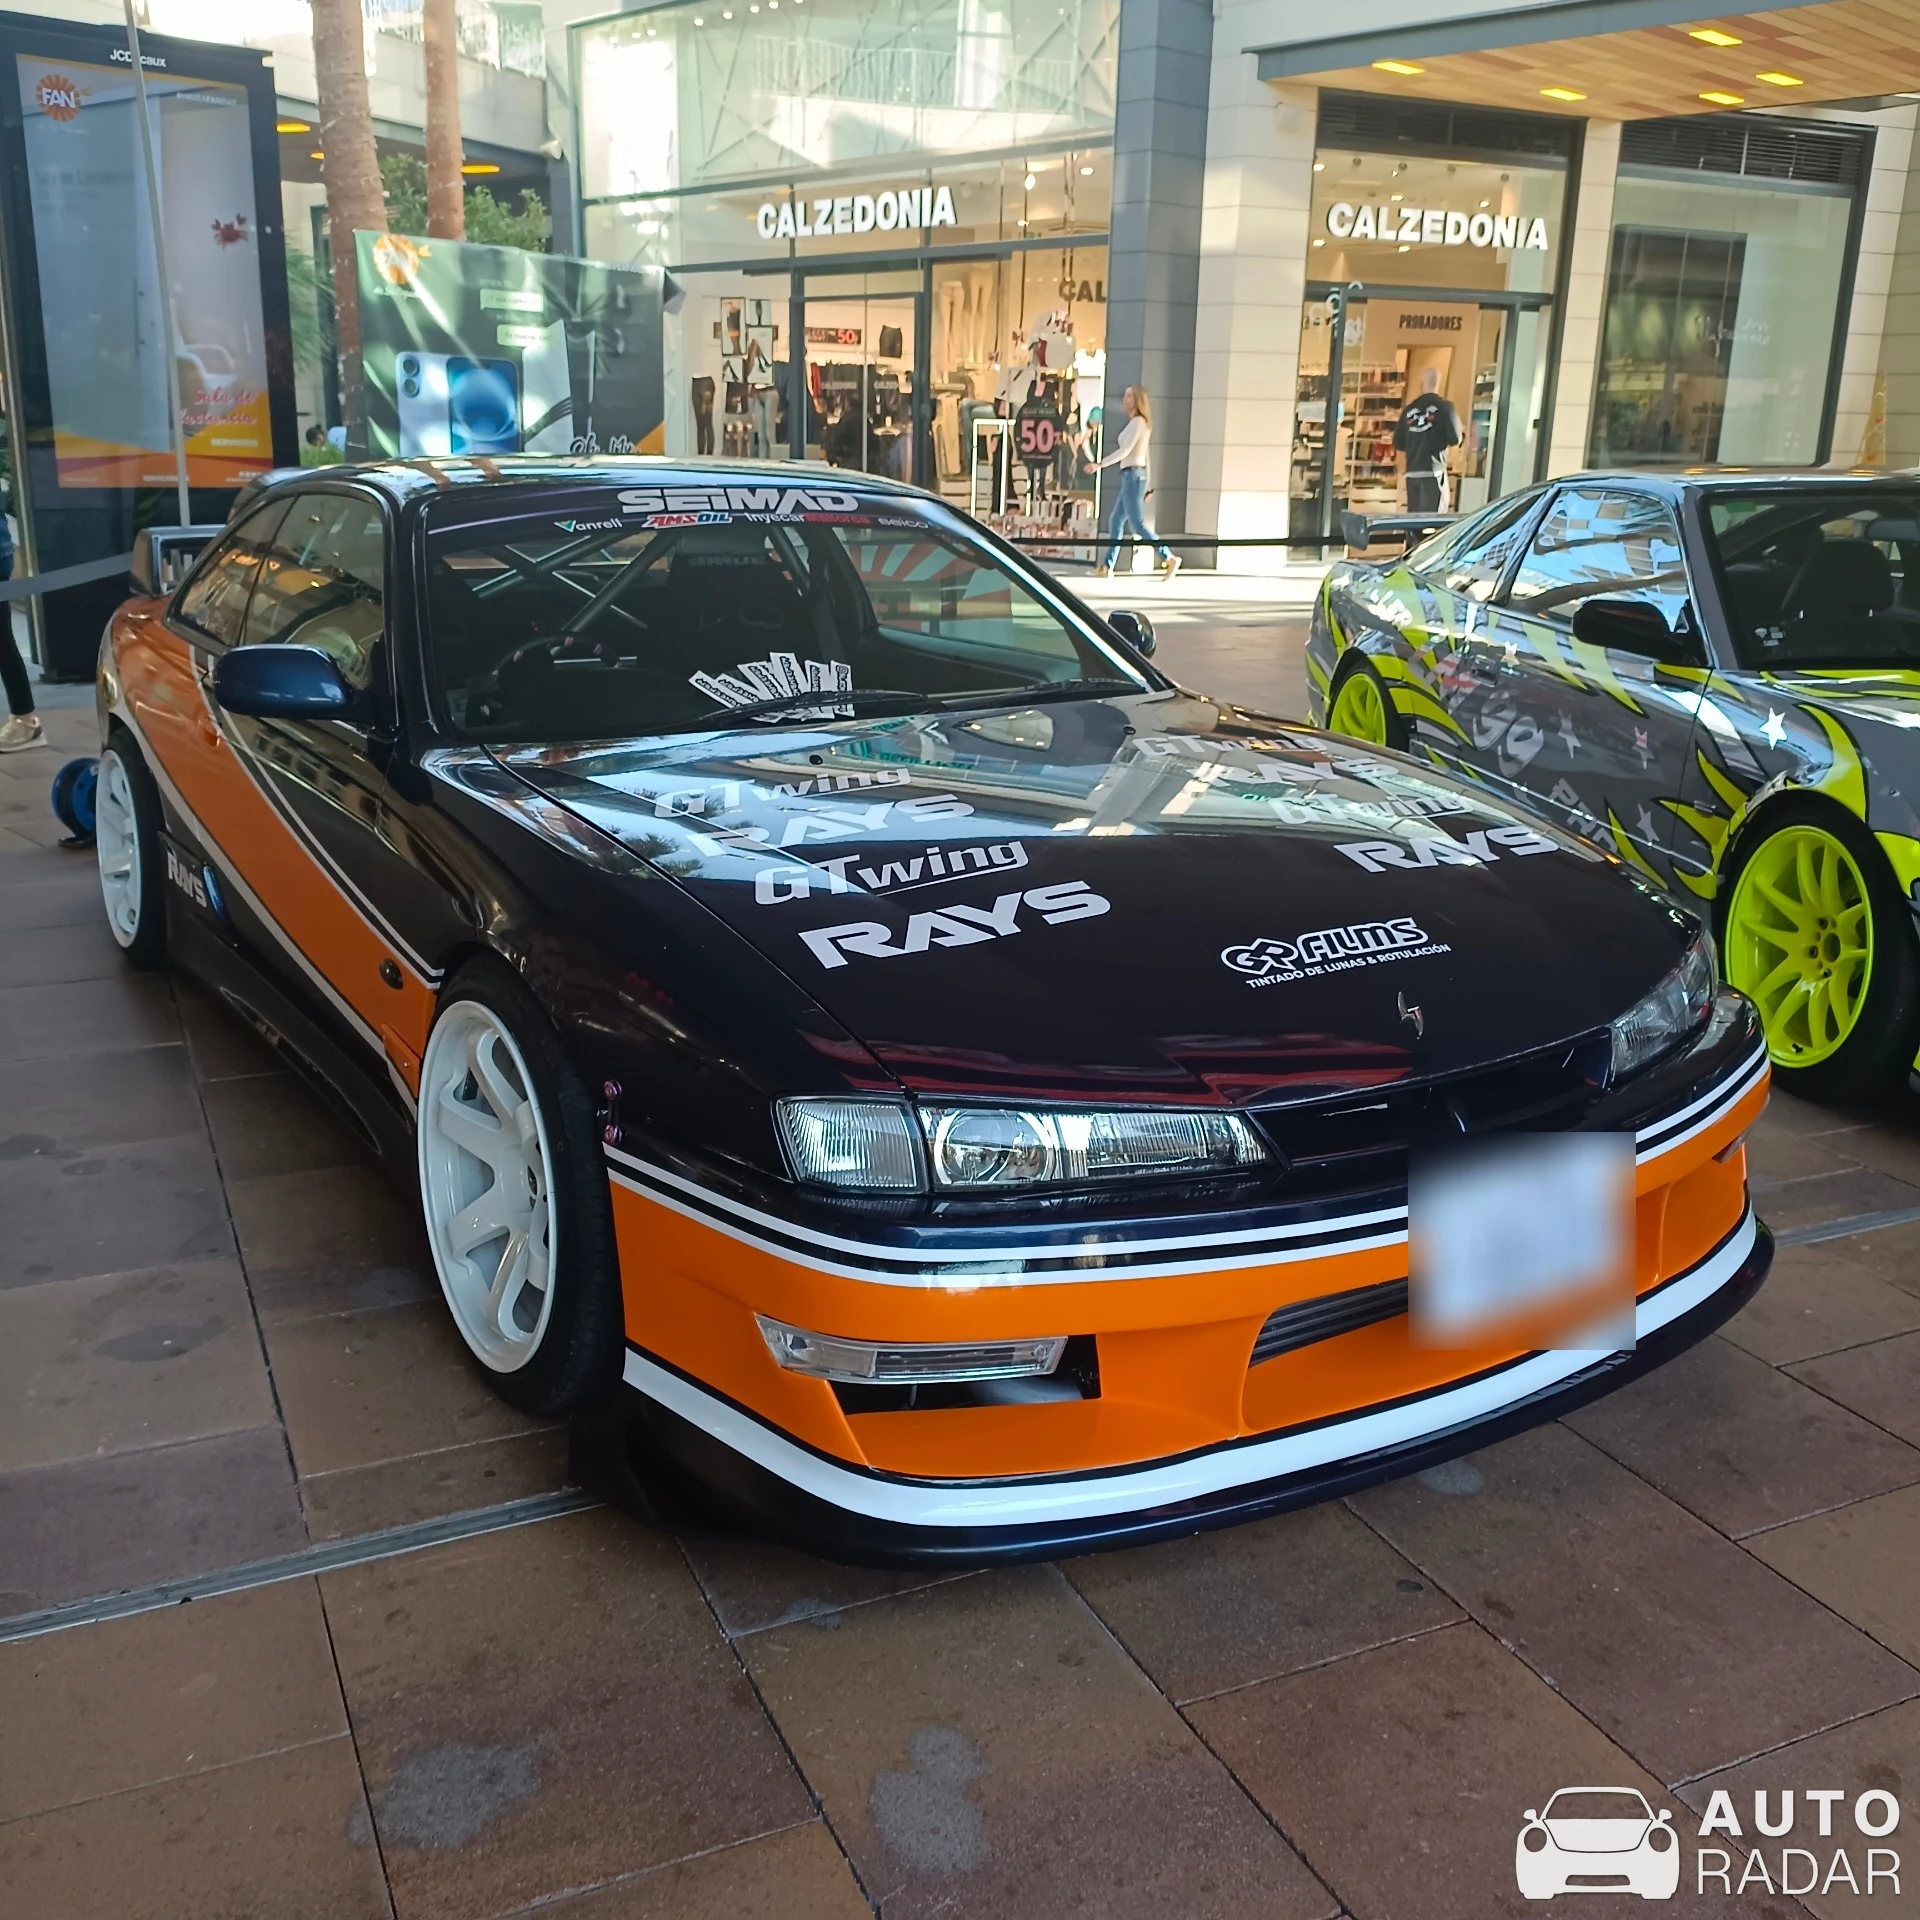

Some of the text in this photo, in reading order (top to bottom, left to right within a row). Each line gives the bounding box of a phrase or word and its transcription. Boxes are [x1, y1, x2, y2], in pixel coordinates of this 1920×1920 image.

[110, 49, 166, 67] JCDcaux
[42, 88, 76, 109] FAN
[756, 186, 957, 239] CALZEDONIA
[1327, 202, 1548, 250] CALZEDONIA
[1399, 314, 1463, 331] PROBADORES
[554, 518, 622, 533] Vanrell
[641, 511, 733, 529] AMSOIL
[655, 768, 912, 818] GTwing
[1187, 757, 1400, 787] RAYS
[686, 793, 975, 857] RAYS
[1333, 825, 1559, 873] RAYS
[167, 852, 207, 908] RAYS
[754, 840, 1028, 905] GTwing
[798, 880, 1111, 969] RAYS
[1246, 944, 1451, 989] TINTADO DE LUNAS & ROTULACIÓN
